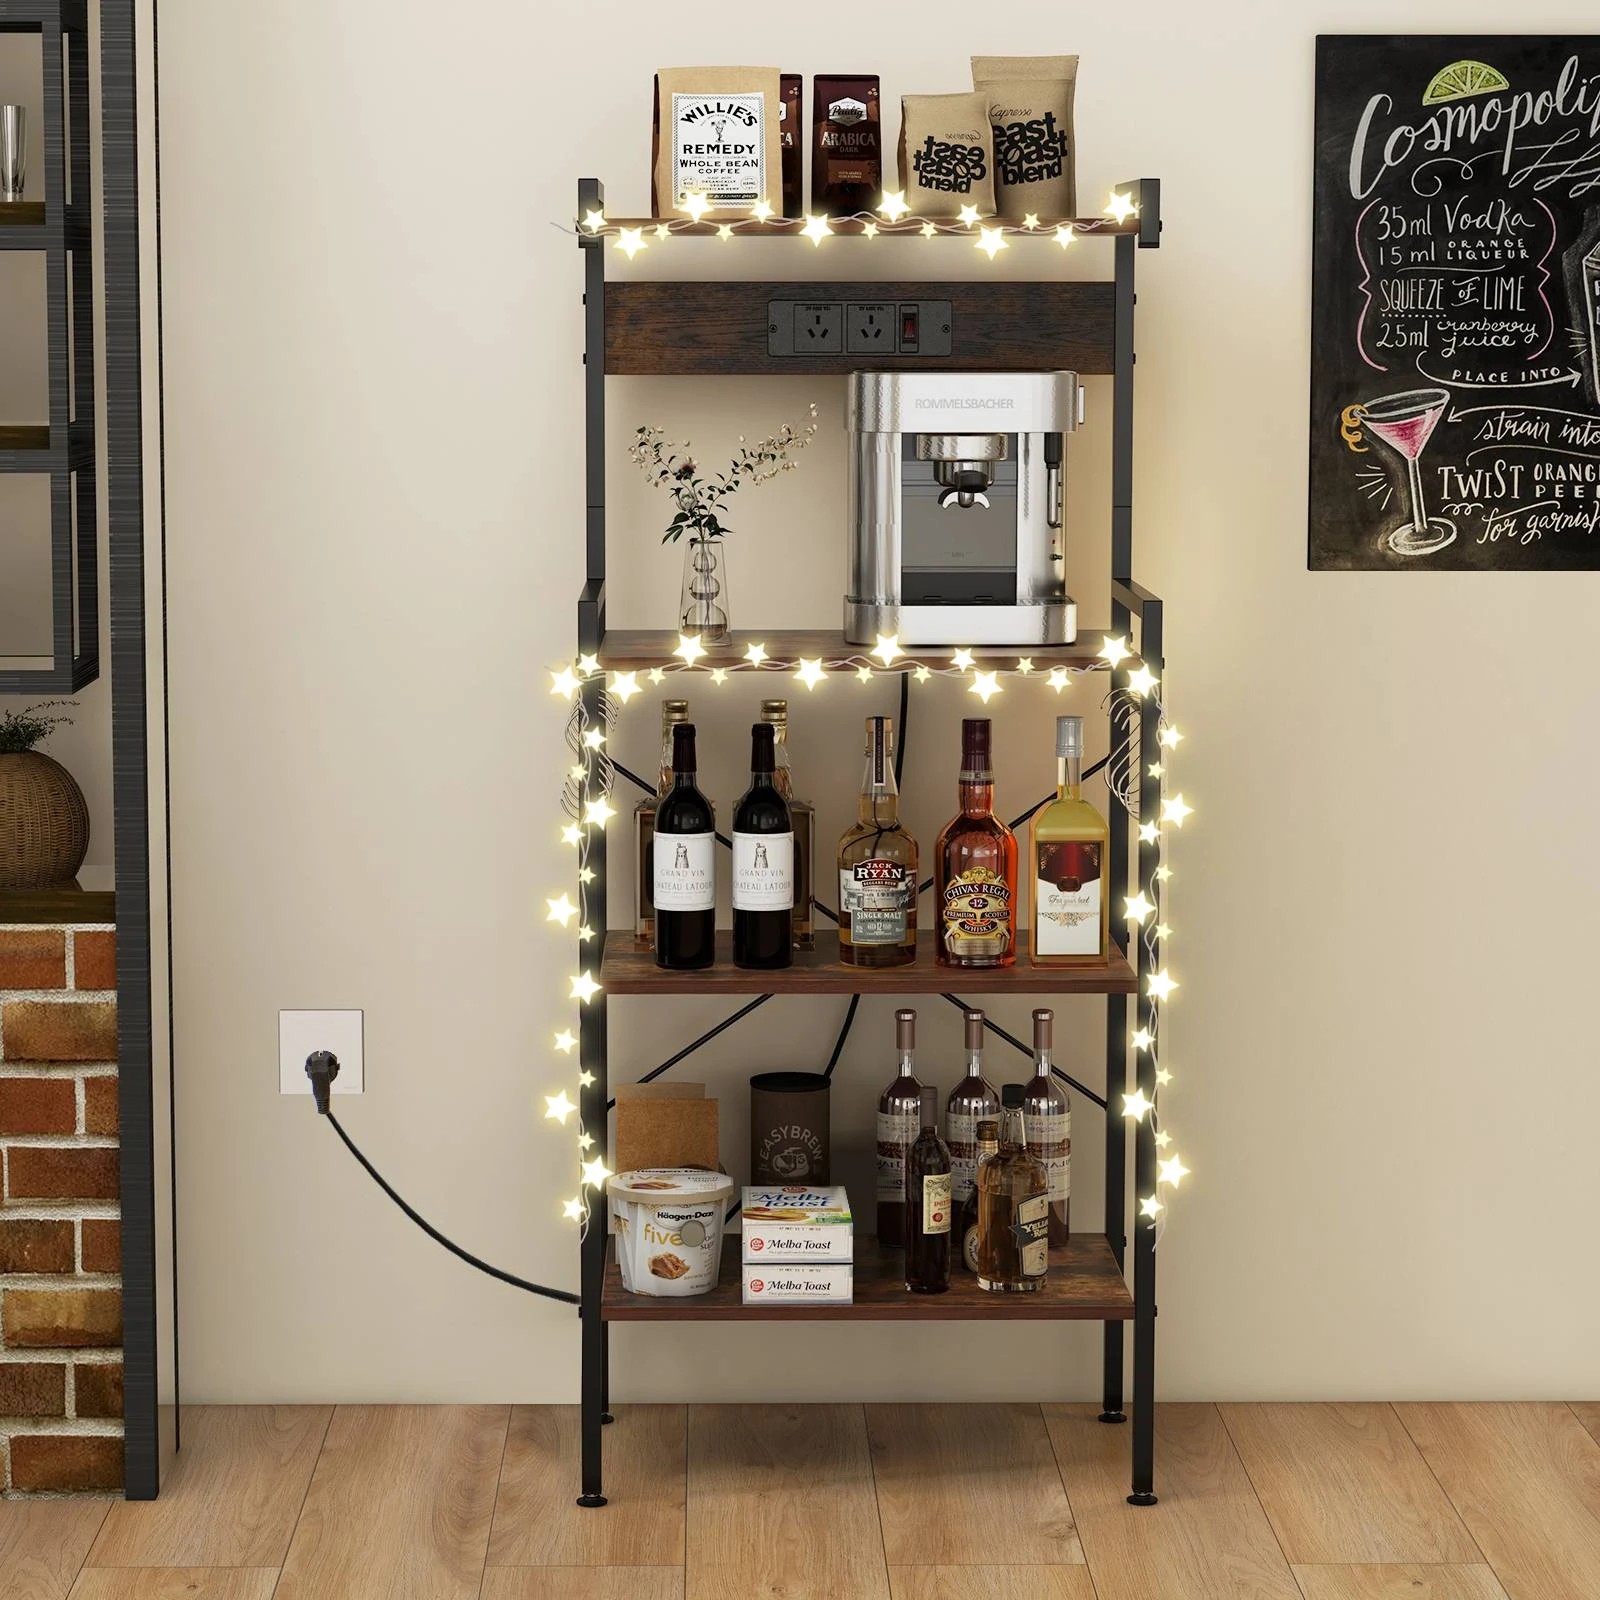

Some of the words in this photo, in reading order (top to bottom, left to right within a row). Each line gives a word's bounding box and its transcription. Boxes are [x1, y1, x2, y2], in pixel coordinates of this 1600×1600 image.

[680, 102, 758, 127] WILLIE'S
[821, 131, 876, 146] ARABICA
[683, 144, 756, 155] REMEDY
[680, 159, 722, 168] WHOLE
[726, 158, 759, 168] BEAN
[1002, 157, 1063, 186] blend
[1377, 203, 1432, 240] 35ml
[1444, 195, 1535, 236] Vodka
[1448, 238, 1525, 248] ORANGE
[1447, 249, 1530, 260] LIQUEUR
[1380, 278, 1445, 312] SQUEEZE
[1483, 275, 1526, 311] LIME
[1376, 319, 1429, 348] 25ml
[1437, 317, 1539, 344] cranberry
[1441, 332, 1516, 358] juice
[1452, 369, 1508, 382] PLACE
[1520, 366, 1560, 382] INTO
[915, 398, 1014, 409] ROMMELSBACHER
[1473, 411, 1550, 443] strain
[1437, 459, 1524, 500] TWIST
[1533, 462, 1600, 482] ORANG
[660, 869, 689, 877] GRAND
[691, 869, 705, 877] VIN
[739, 869, 767, 877] GRAND
[770, 869, 784, 877] VIN
[856, 867, 902, 879] RYAN
[946, 884, 979, 900] CHIVAS
[982, 884, 1010, 901] REGAL
[973, 899, 983, 908] 12
[857, 912, 882, 920] SINGLE
[884, 911, 903, 919] MALT
[946, 911, 975, 919] PREMIUM
[963, 924, 992, 932] WHISKY
[760, 1125, 823, 1160] EASYBREW
[644, 1223, 684, 1246] five
[767, 1239, 802, 1250] Melba
[803, 1239, 831, 1250] Toast
[767, 1280, 802, 1291] Melba
[803, 1281, 831, 1291] Toast
